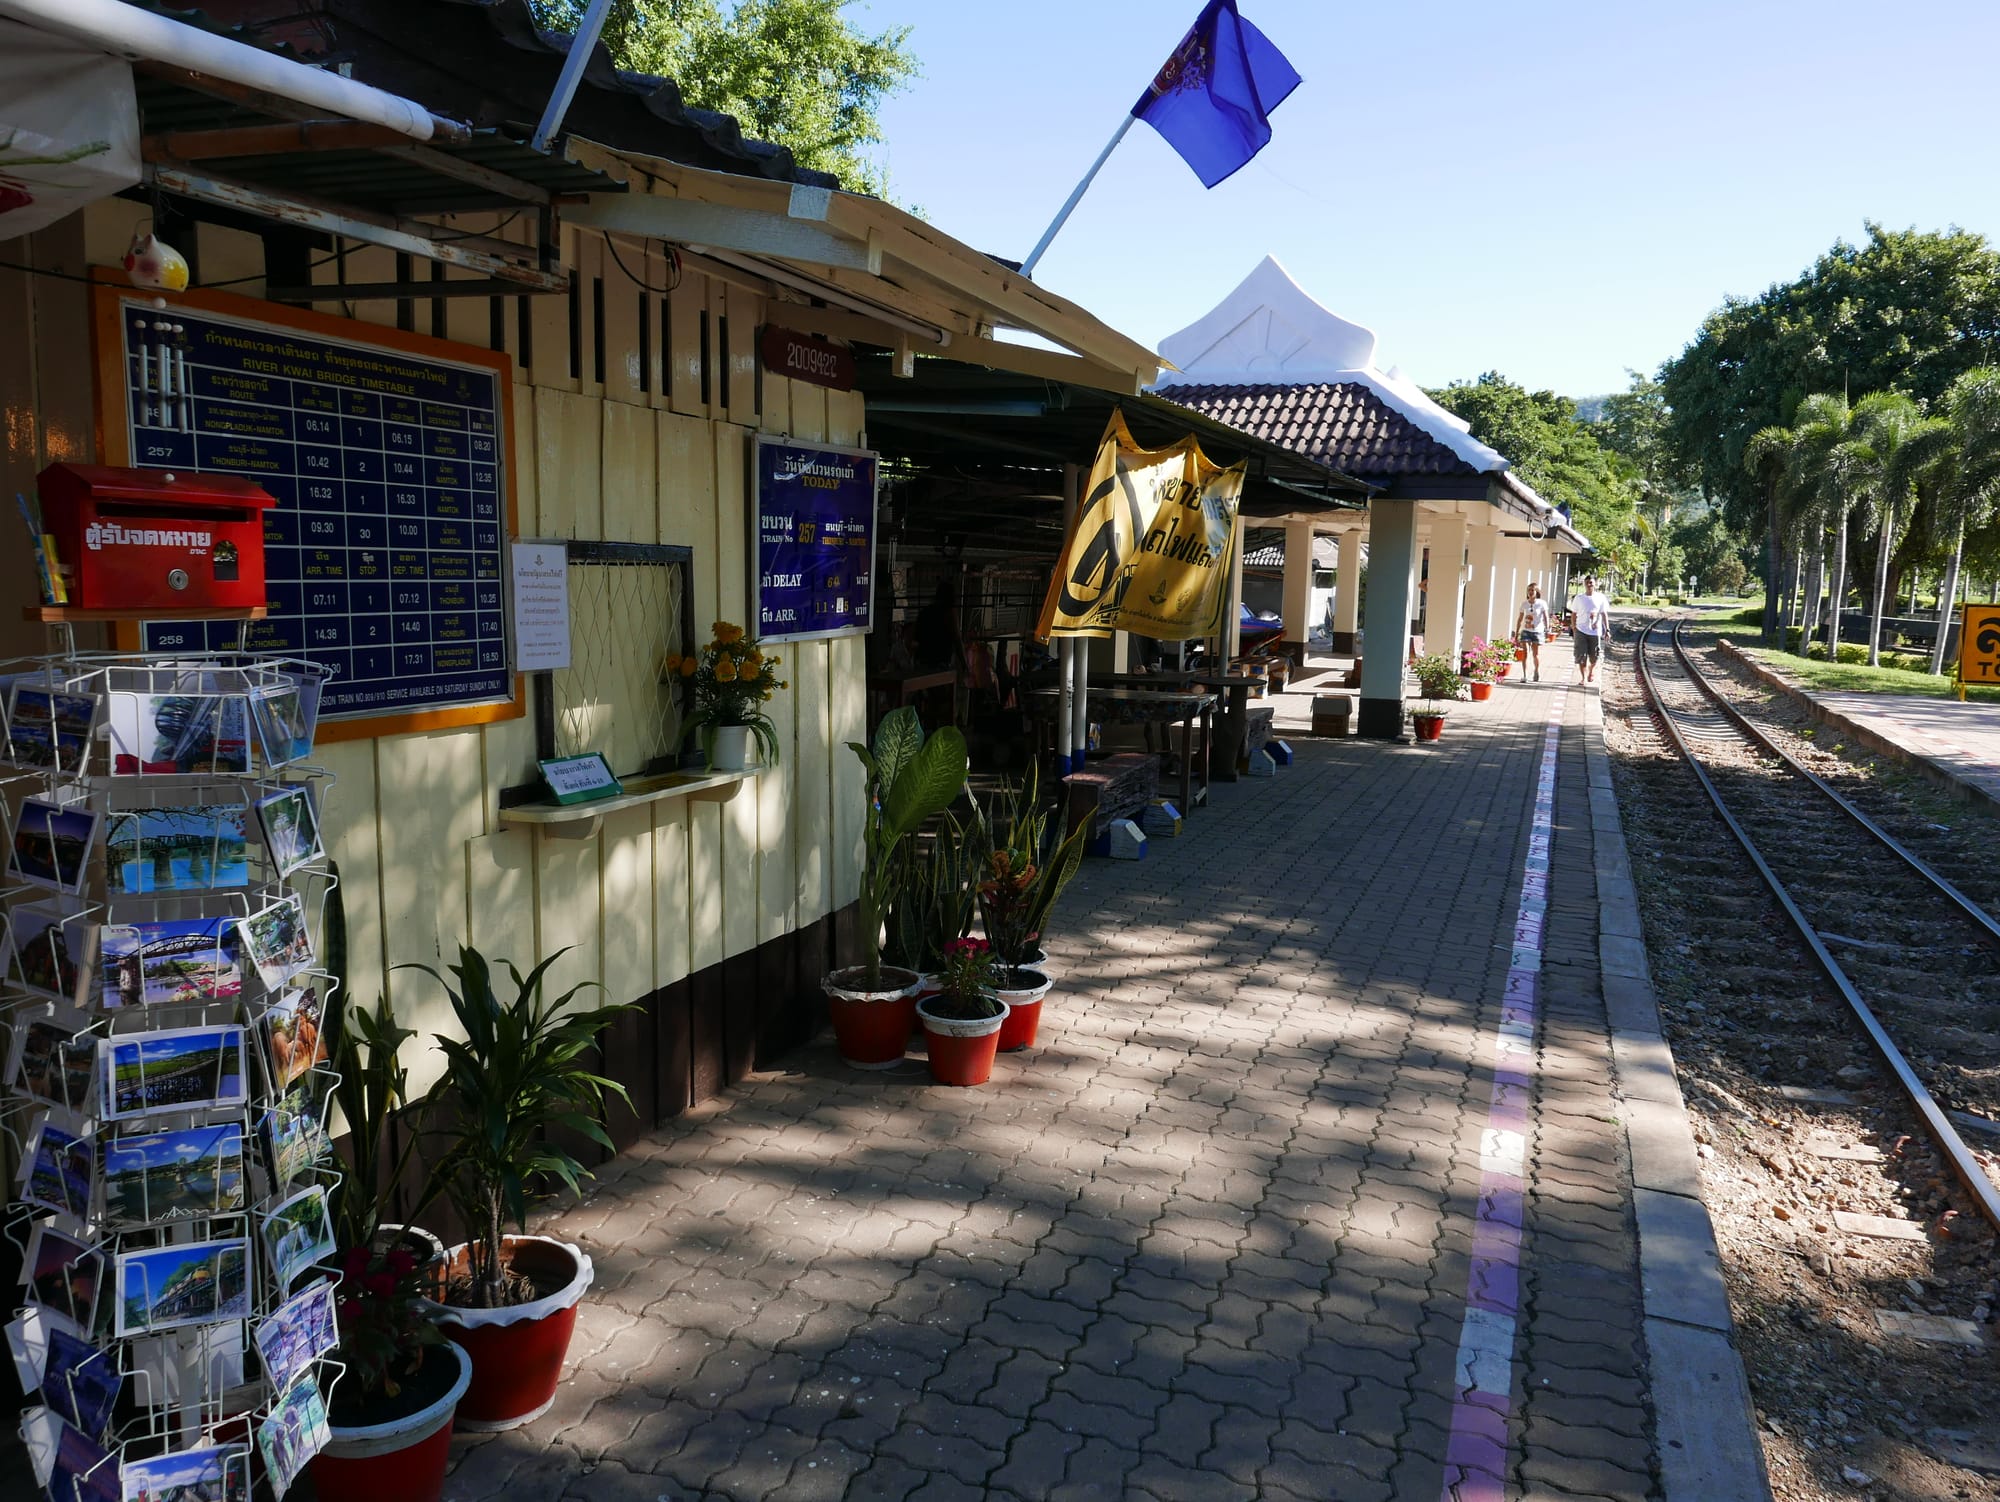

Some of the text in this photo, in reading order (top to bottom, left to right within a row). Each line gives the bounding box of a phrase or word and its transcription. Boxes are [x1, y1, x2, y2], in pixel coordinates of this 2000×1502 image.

[242, 357, 415, 395] RIVER KWAI BRIDGE TIMETABLE
[229, 389, 256, 400] ROUTE
[305, 419, 330, 433] 06.14
[357, 426, 363, 437] 1
[391, 432, 413, 446] 06.15
[147, 445, 174, 457] 257
[473, 440, 492, 452] 08.20
[306, 455, 330, 469] 10.42
[359, 461, 366, 473] 2
[393, 462, 413, 475] 10.44
[475, 472, 492, 483] 12.35
[801, 475, 841, 490] TODAY
[309, 487, 333, 499] 16.32
[396, 493, 416, 505] 16.33
[360, 495, 365, 505] 1
[476, 503, 494, 515] 18.30
[310, 521, 334, 534] 09.30
[761, 514, 793, 530] ขบวน
[359, 528, 371, 539] 30
[399, 524, 418, 536] 10.00
[798, 522, 817, 544] 257
[85, 522, 212, 551] ตู้รับจดหมาย
[479, 533, 496, 544] 11.30
[761, 534, 783, 543] TRAIN
[306, 566, 344, 576] ARR. TIME
[359, 566, 378, 576] STOP
[409, 566, 425, 576] TIME
[773, 573, 803, 588] DELAY
[313, 594, 337, 606] 07.11
[367, 595, 373, 606] 1
[399, 593, 421, 605] 07.12
[480, 593, 497, 604] 10.25
[774, 608, 797, 622] ARR.
[369, 626, 377, 637] 2
[400, 621, 421, 633] 14.40
[481, 621, 498, 632] 17.40
[158, 635, 185, 645] 258
[315, 629, 338, 641] 14.38
[404, 653, 424, 665] 17.31
[482, 651, 499, 662] 18.50
[369, 658, 374, 668] 1
[337, 694, 354, 705] TRAIN
[386, 688, 409, 700] SERVICE
[409, 684, 436, 697] AVAILABLE
[435, 684, 443, 695] ON
[444, 682, 468, 694] SATURDAY
[468, 680, 488, 692] SUNDAY
